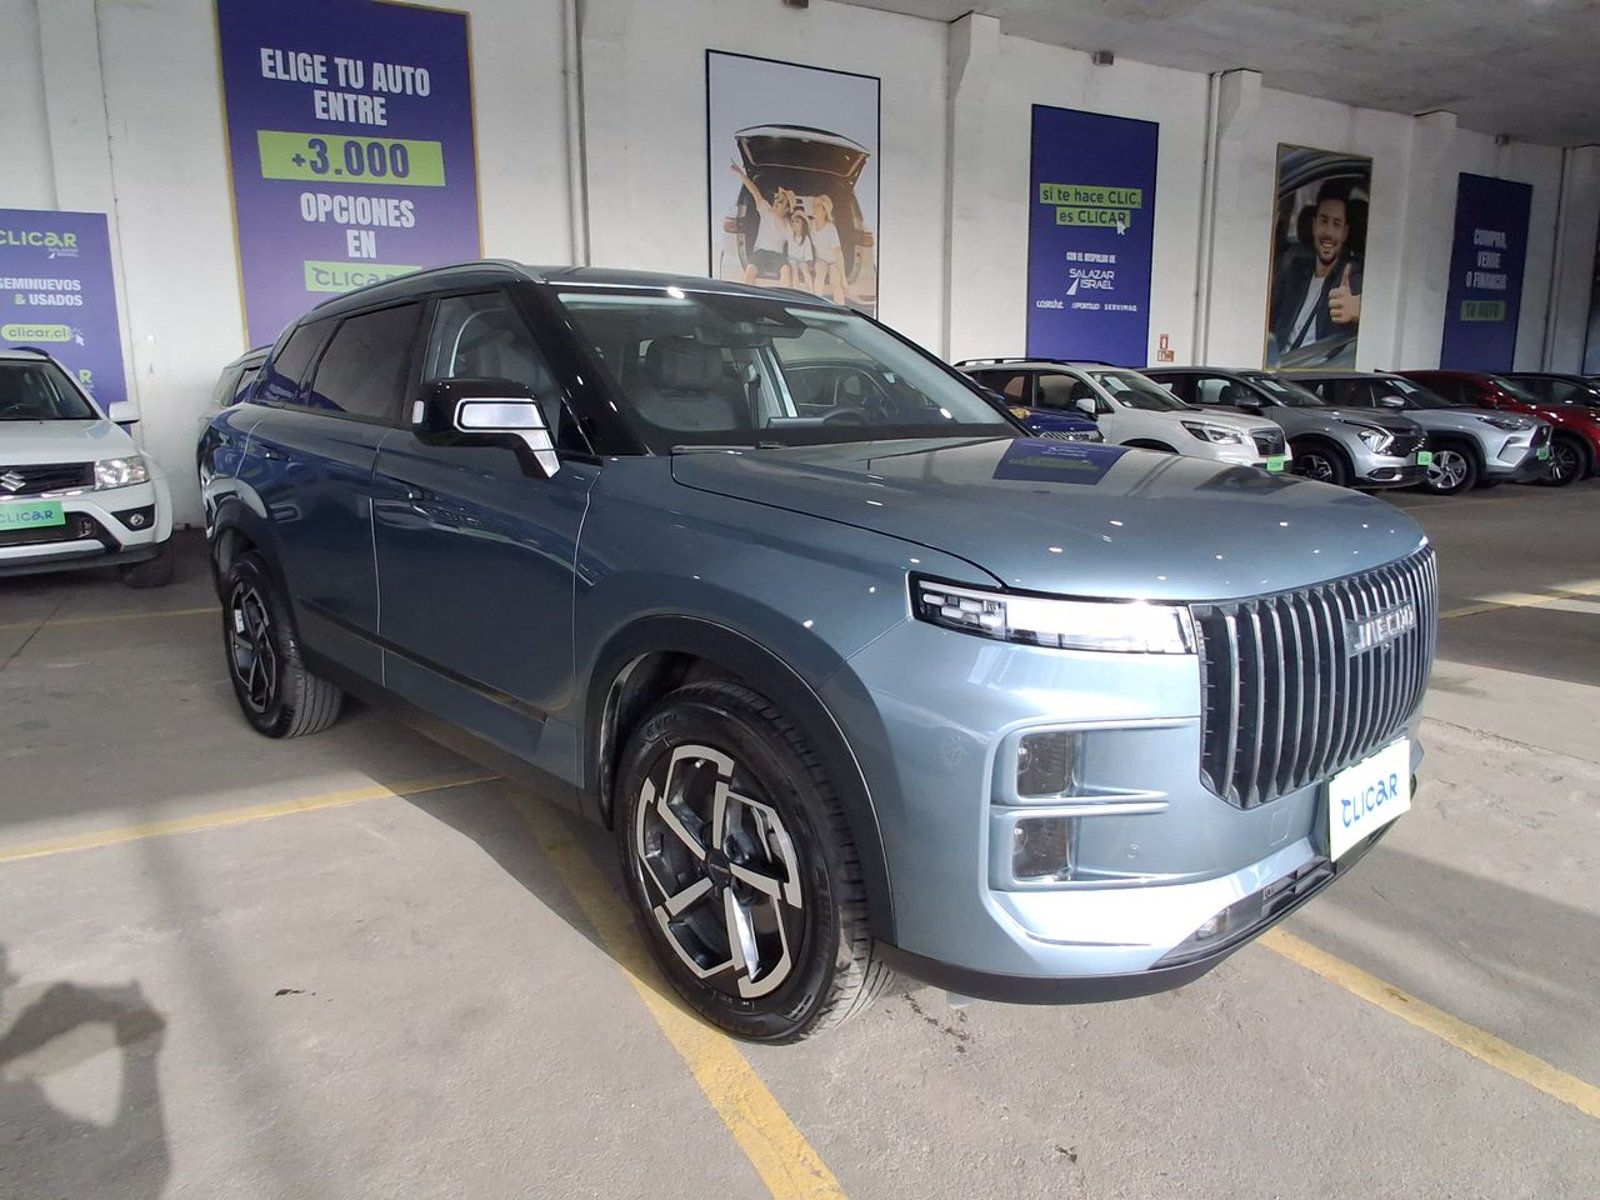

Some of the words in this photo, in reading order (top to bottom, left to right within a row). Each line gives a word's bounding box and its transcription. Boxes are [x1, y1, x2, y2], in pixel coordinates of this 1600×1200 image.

[260, 47, 328, 85] ELIGE
[333, 57, 365, 89] TU
[372, 62, 431, 97] AUTO
[313, 89, 388, 126] ENTRE
[291, 138, 410, 178] +3.000
[1042, 187, 1053, 200] si
[1058, 189, 1070, 201] te
[1074, 188, 1104, 203] hace
[300, 192, 416, 228] OPCIONES
[1060, 213, 1074, 222] es
[1078, 210, 1126, 225] CLICAR
[346, 229, 377, 259] EN
[1069, 268, 1115, 280] SALAZAR
[1080, 279, 1115, 290] ISRAEL
[15, 293, 26, 305] &
[29, 293, 84, 307] USADOS
[8, 327, 67, 339] clicar.cl
